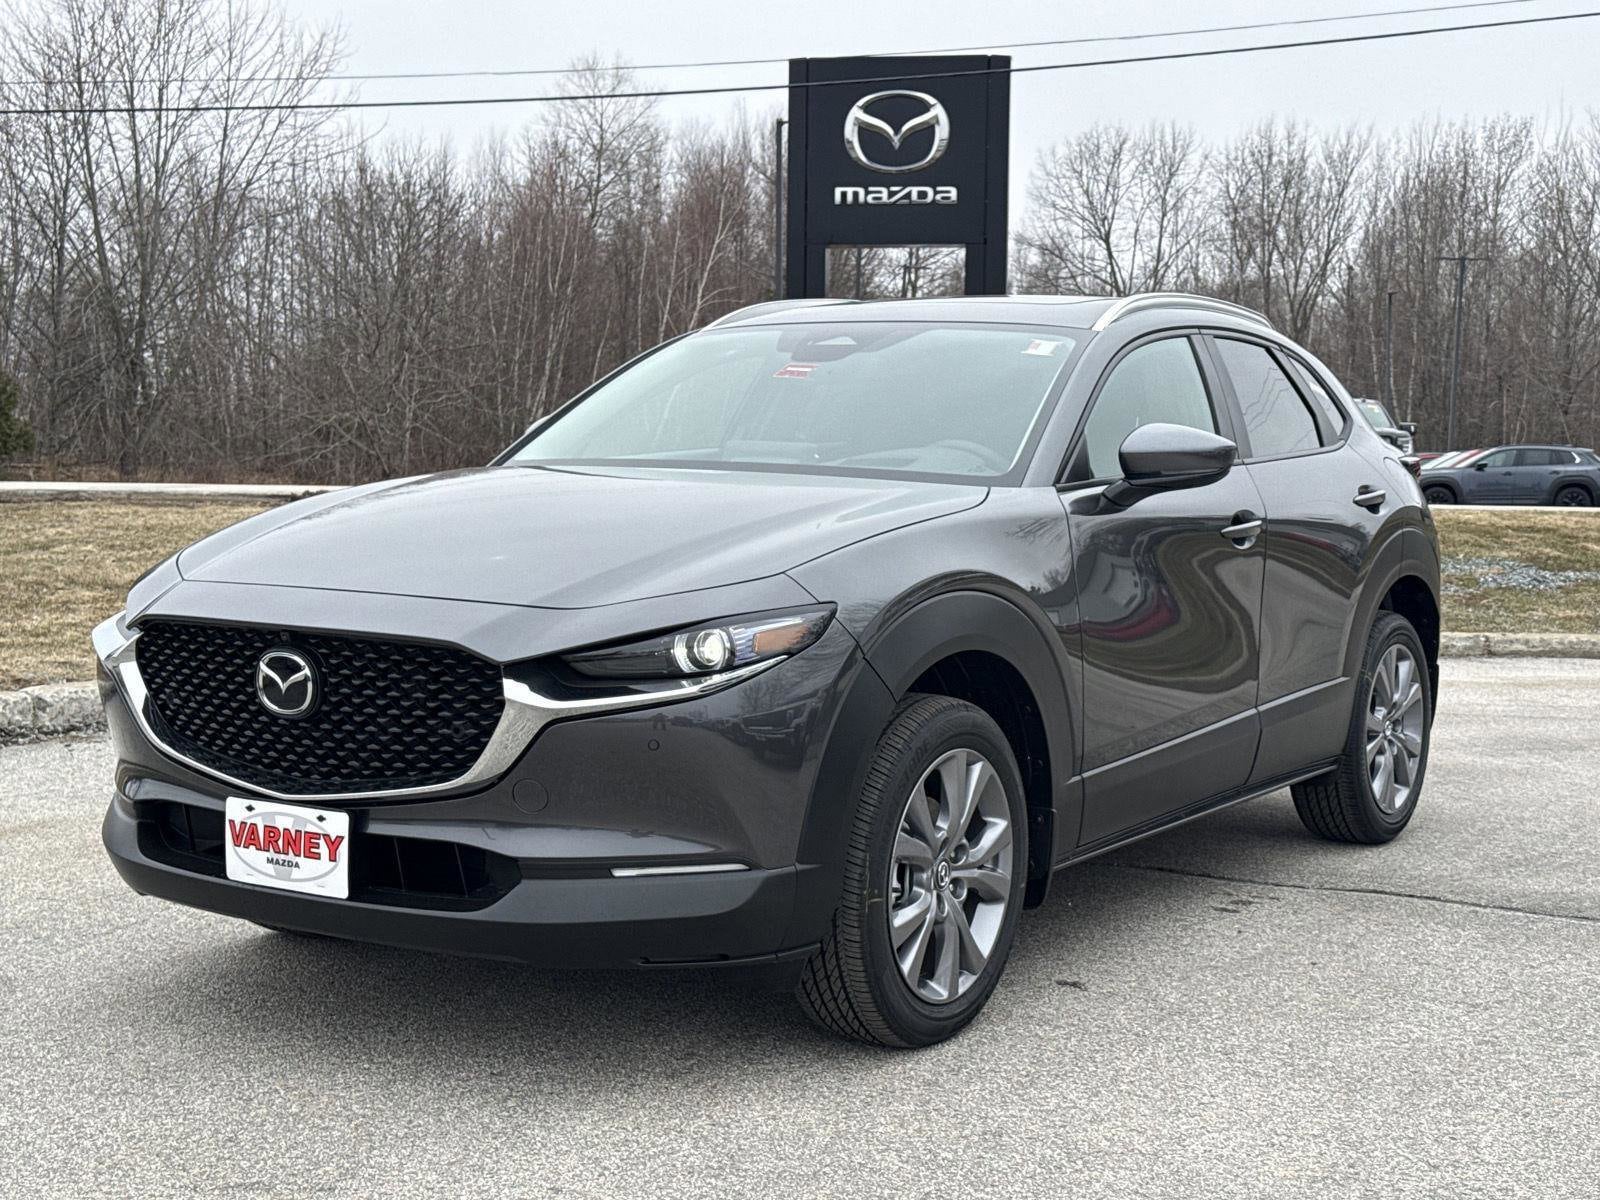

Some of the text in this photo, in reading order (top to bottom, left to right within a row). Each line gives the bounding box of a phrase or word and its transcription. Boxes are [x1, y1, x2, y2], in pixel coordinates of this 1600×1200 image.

[833, 185, 958, 205] mazda
[228, 819, 345, 863] VARNEY
[266, 856, 301, 870] MAZDA
